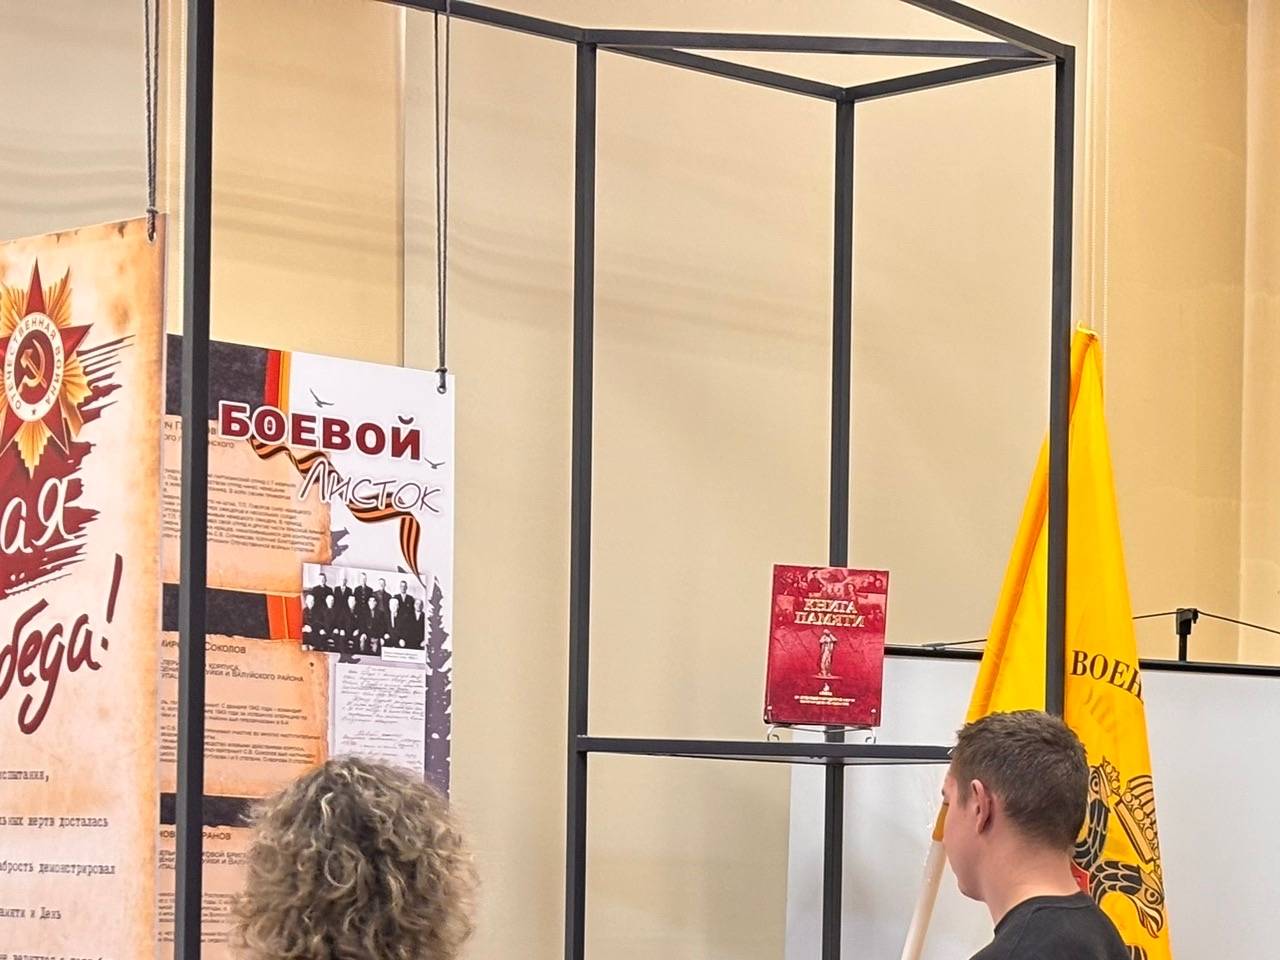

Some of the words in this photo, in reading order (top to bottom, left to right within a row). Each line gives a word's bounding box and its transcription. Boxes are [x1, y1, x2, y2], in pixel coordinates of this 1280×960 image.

[221, 403, 420, 461] БОЕВОЙ
[803, 599, 858, 613] КНИГА
[794, 611, 865, 627] ПАМЯТИ
[59, 818, 108, 828] досталась
[39, 863, 116, 876] демонстрировал
[40, 906, 61, 920] День
